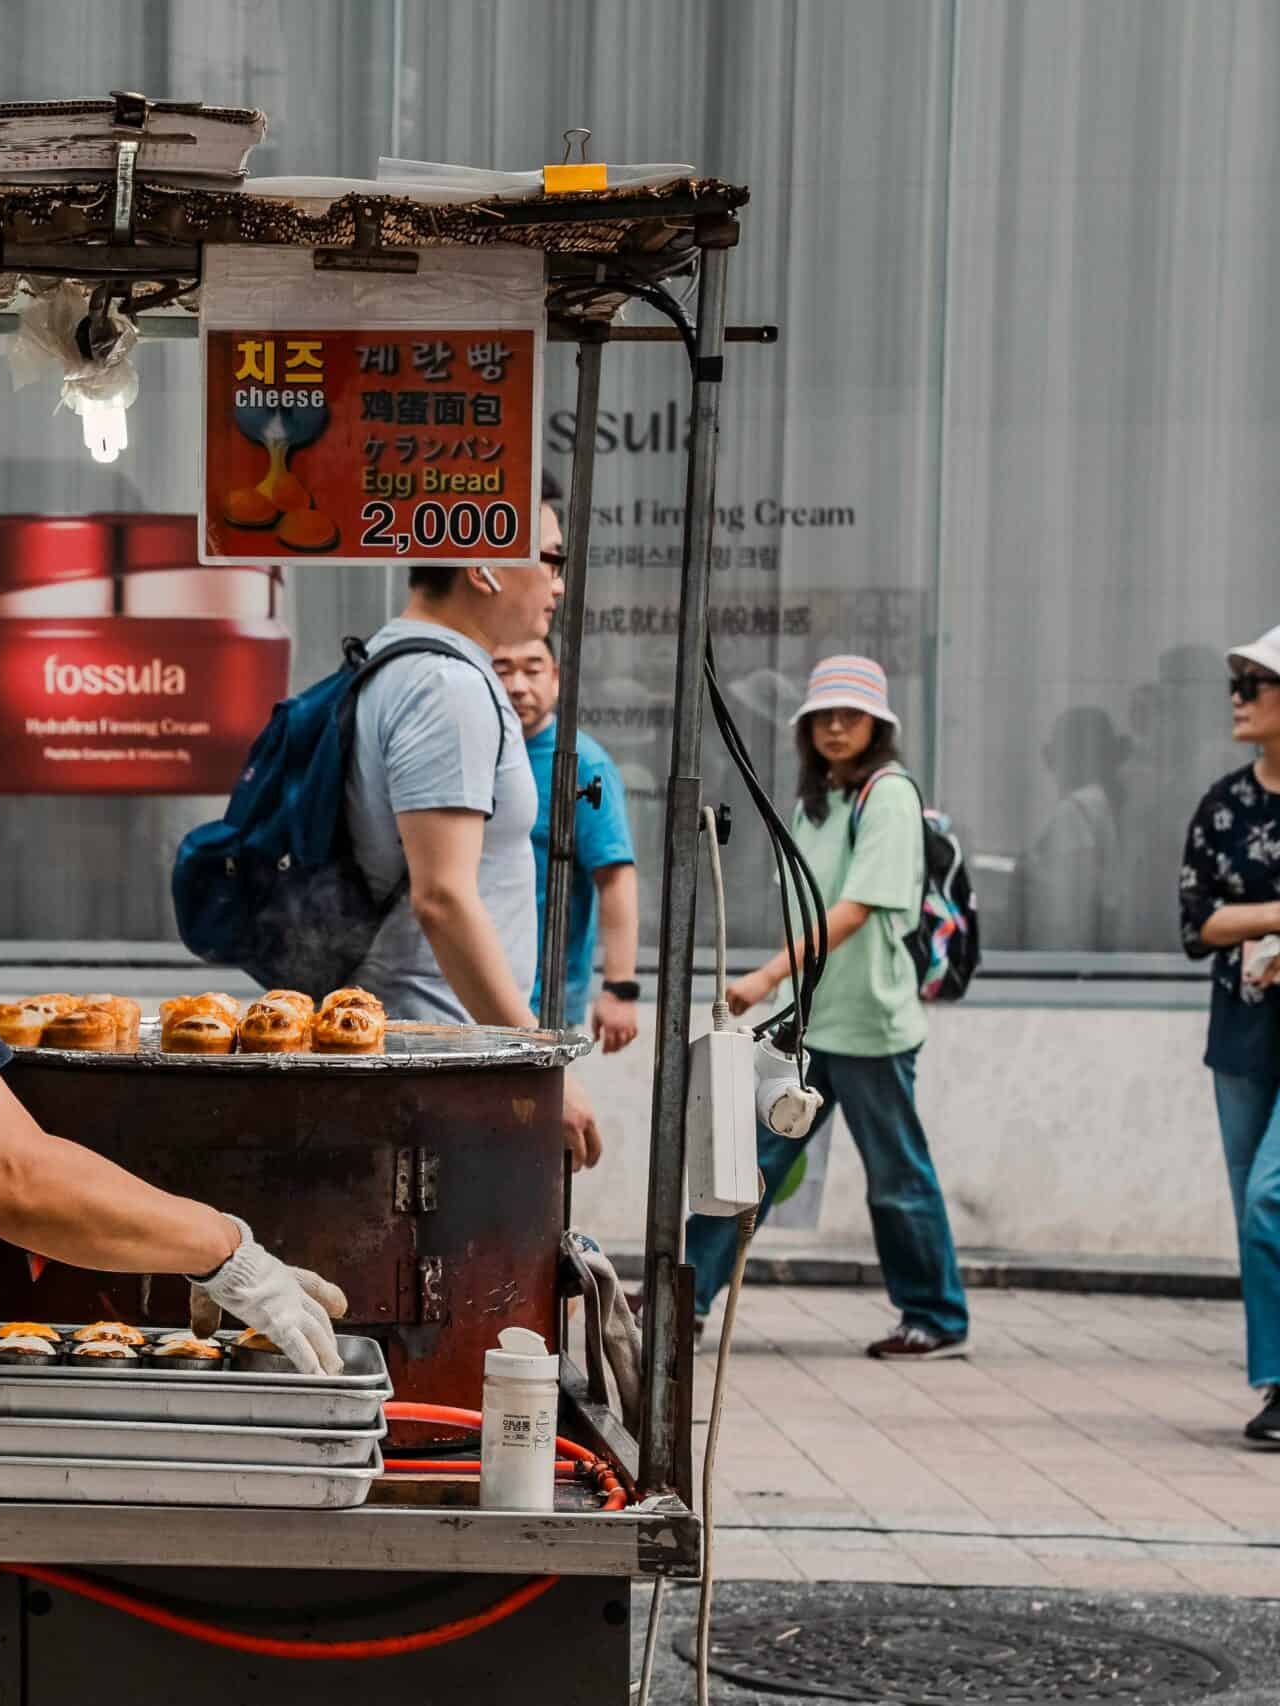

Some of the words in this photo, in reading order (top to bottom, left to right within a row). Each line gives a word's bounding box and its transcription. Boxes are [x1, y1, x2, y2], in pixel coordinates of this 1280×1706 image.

[234, 340, 324, 385] 치즈
[234, 386, 325, 408] cheese
[360, 391, 503, 426] 鸡蛋面包
[547, 401, 692, 454] ssul
[361, 466, 412, 498] Egg
[422, 465, 500, 492] Bread
[360, 500, 519, 553] 2,000
[632, 499, 745, 531] Firng
[754, 498, 856, 528] Cream
[43, 653, 187, 696] fossula
